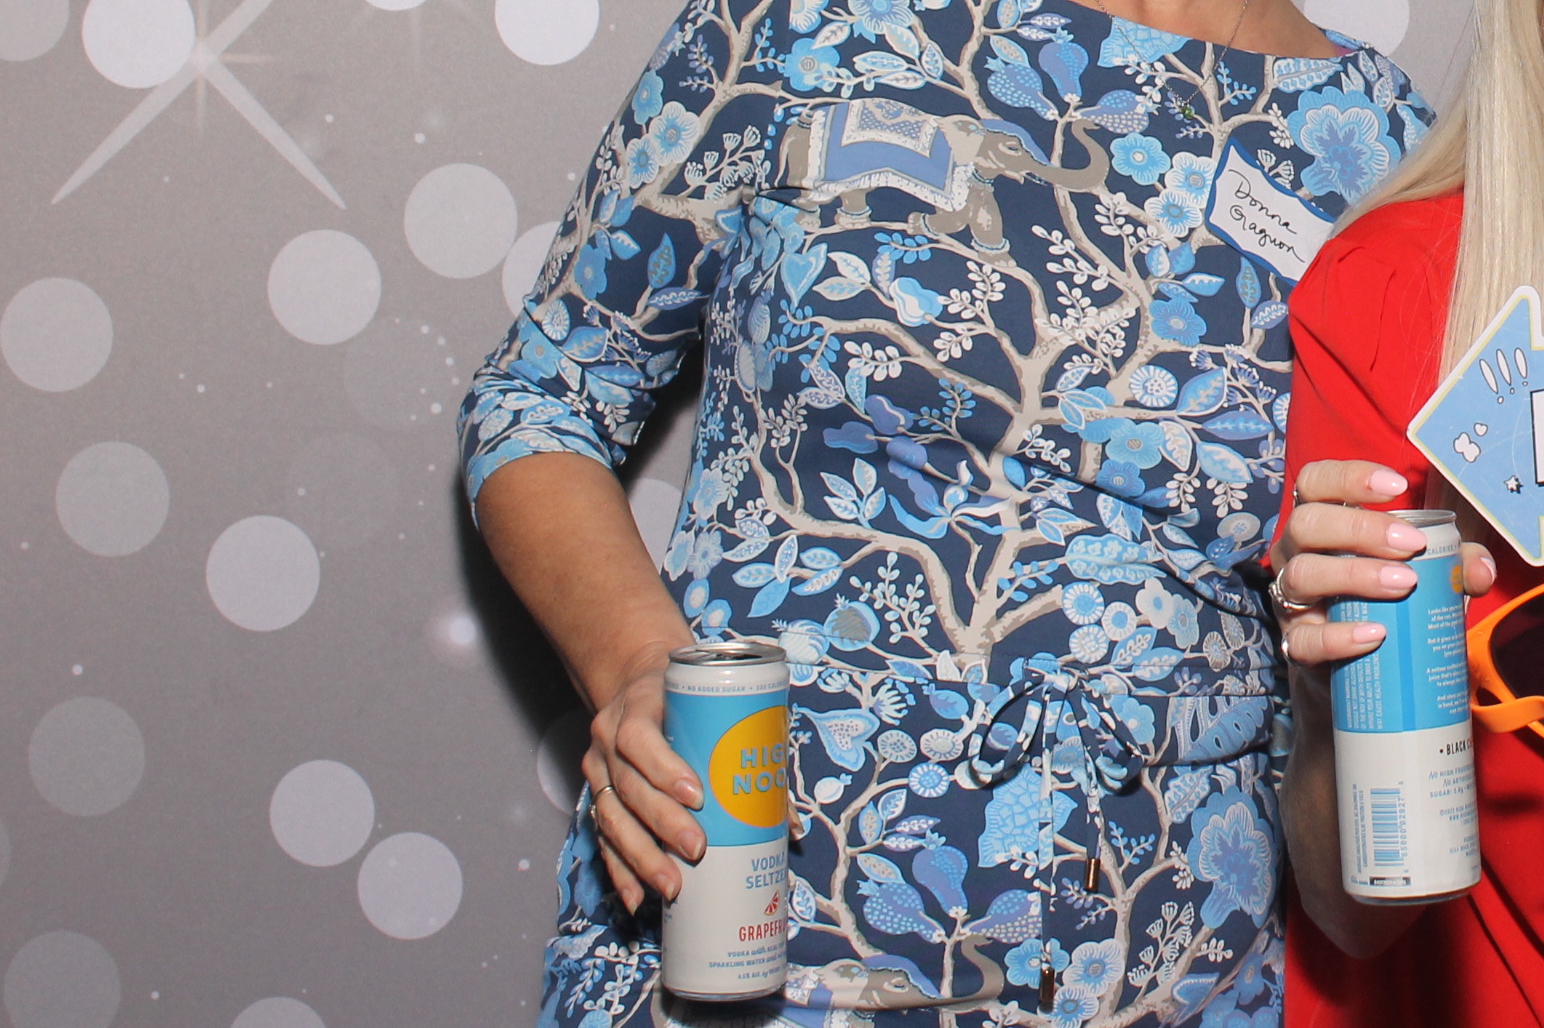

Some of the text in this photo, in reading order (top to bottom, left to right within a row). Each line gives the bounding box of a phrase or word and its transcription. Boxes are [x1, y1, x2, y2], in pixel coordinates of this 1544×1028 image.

[1228, 169, 1298, 235] Donna
[740, 742, 785, 769] HIG
[1446, 739, 1466, 755] BLACK
[732, 767, 787, 795] NOO
[745, 868, 787, 890] SELTZE
